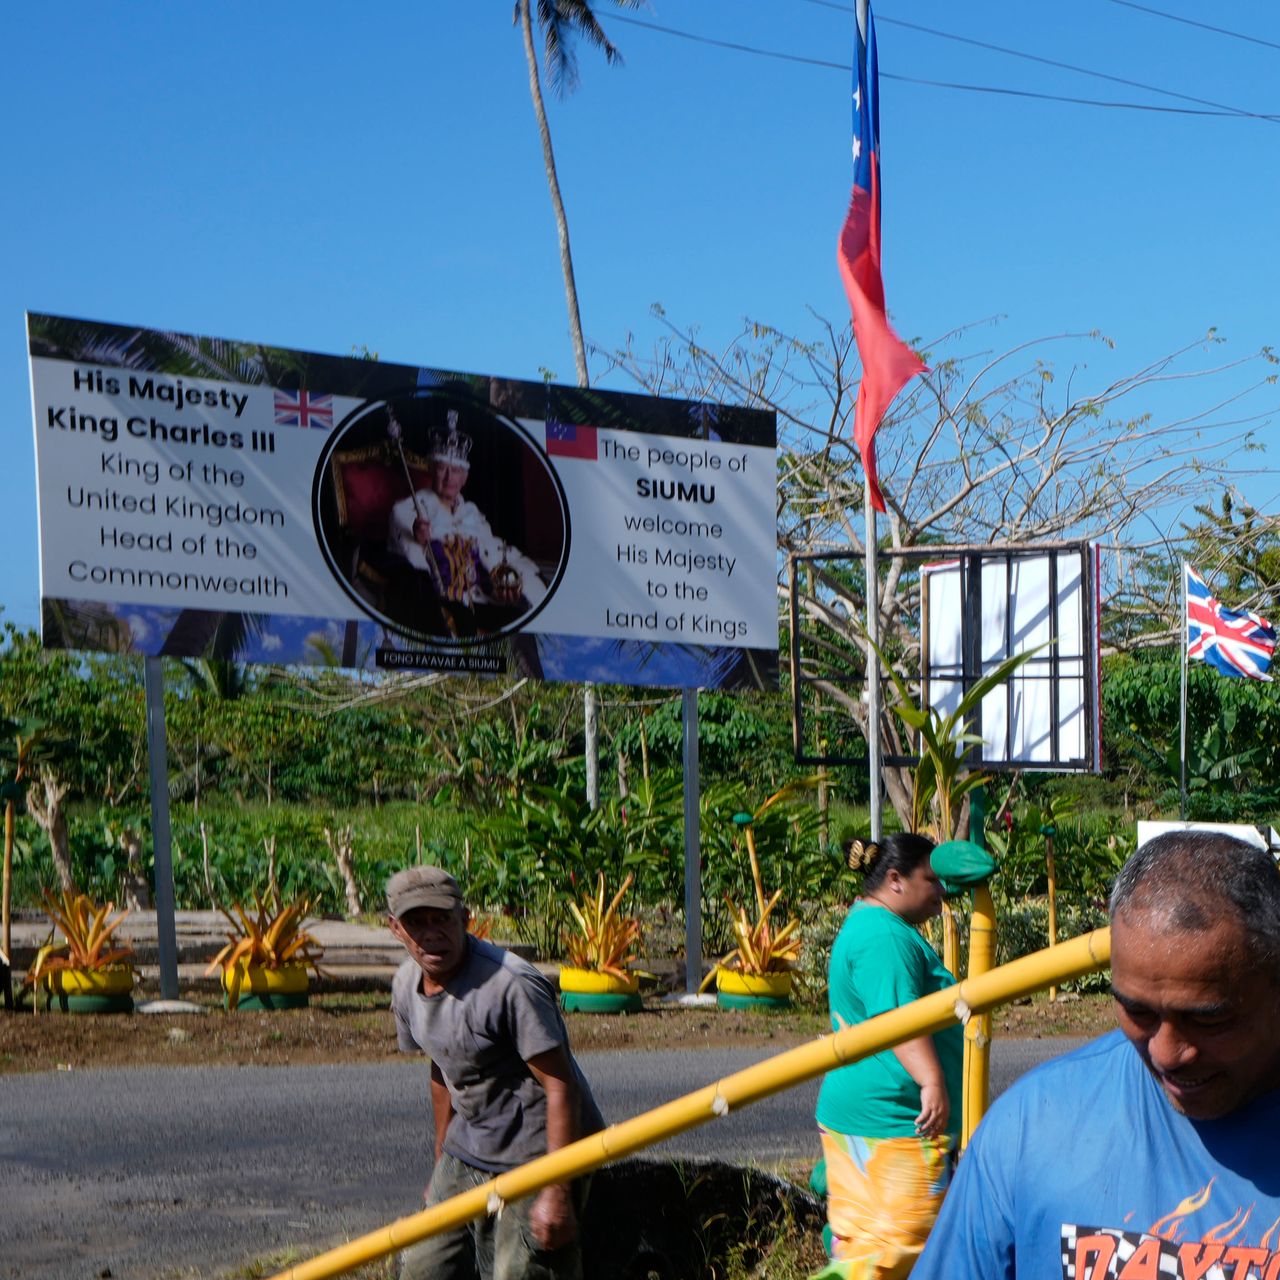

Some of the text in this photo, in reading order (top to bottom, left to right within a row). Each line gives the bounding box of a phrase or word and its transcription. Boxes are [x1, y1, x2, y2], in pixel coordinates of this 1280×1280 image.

[73, 368, 249, 417] His Majesty
[47, 405, 275, 453] King Charles III
[101, 451, 245, 488] King of the
[601, 438, 748, 473] The people of
[67, 486, 285, 528] United Kingdom
[636, 477, 716, 504] SIUMU
[100, 525, 257, 561] Head of the
[624, 514, 723, 539] welcome
[617, 544, 736, 577] His Majesty
[68, 559, 289, 598] Commonwealth
[647, 579, 708, 601] to the
[606, 608, 748, 641] Land of Kings
[384, 652, 413, 665] FONO
[459, 659, 466, 669] A
